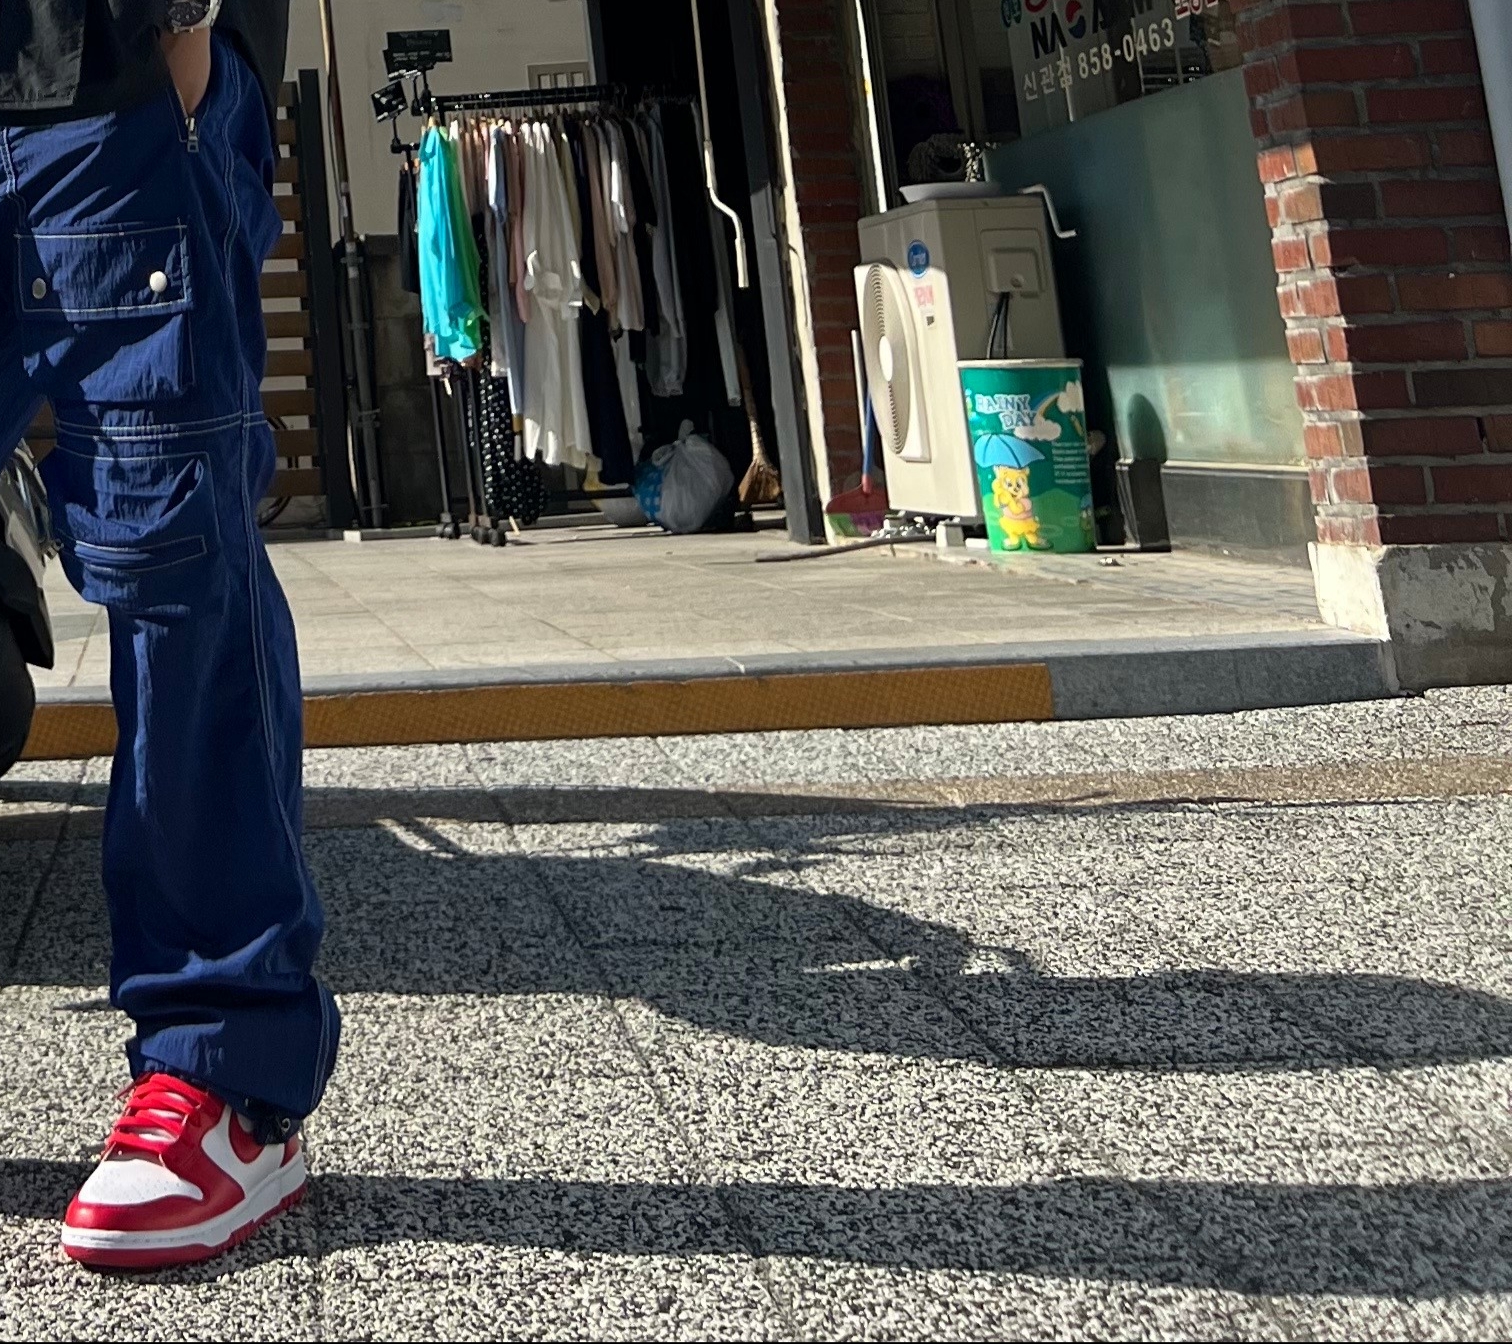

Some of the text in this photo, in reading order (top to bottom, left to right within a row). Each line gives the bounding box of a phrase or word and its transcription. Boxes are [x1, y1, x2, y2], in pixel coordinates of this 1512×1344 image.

[1023, 18, 1175, 101] 신관점 858-0463
[975, 393, 1030, 414] RAINY
[999, 410, 1037, 431] DAY
